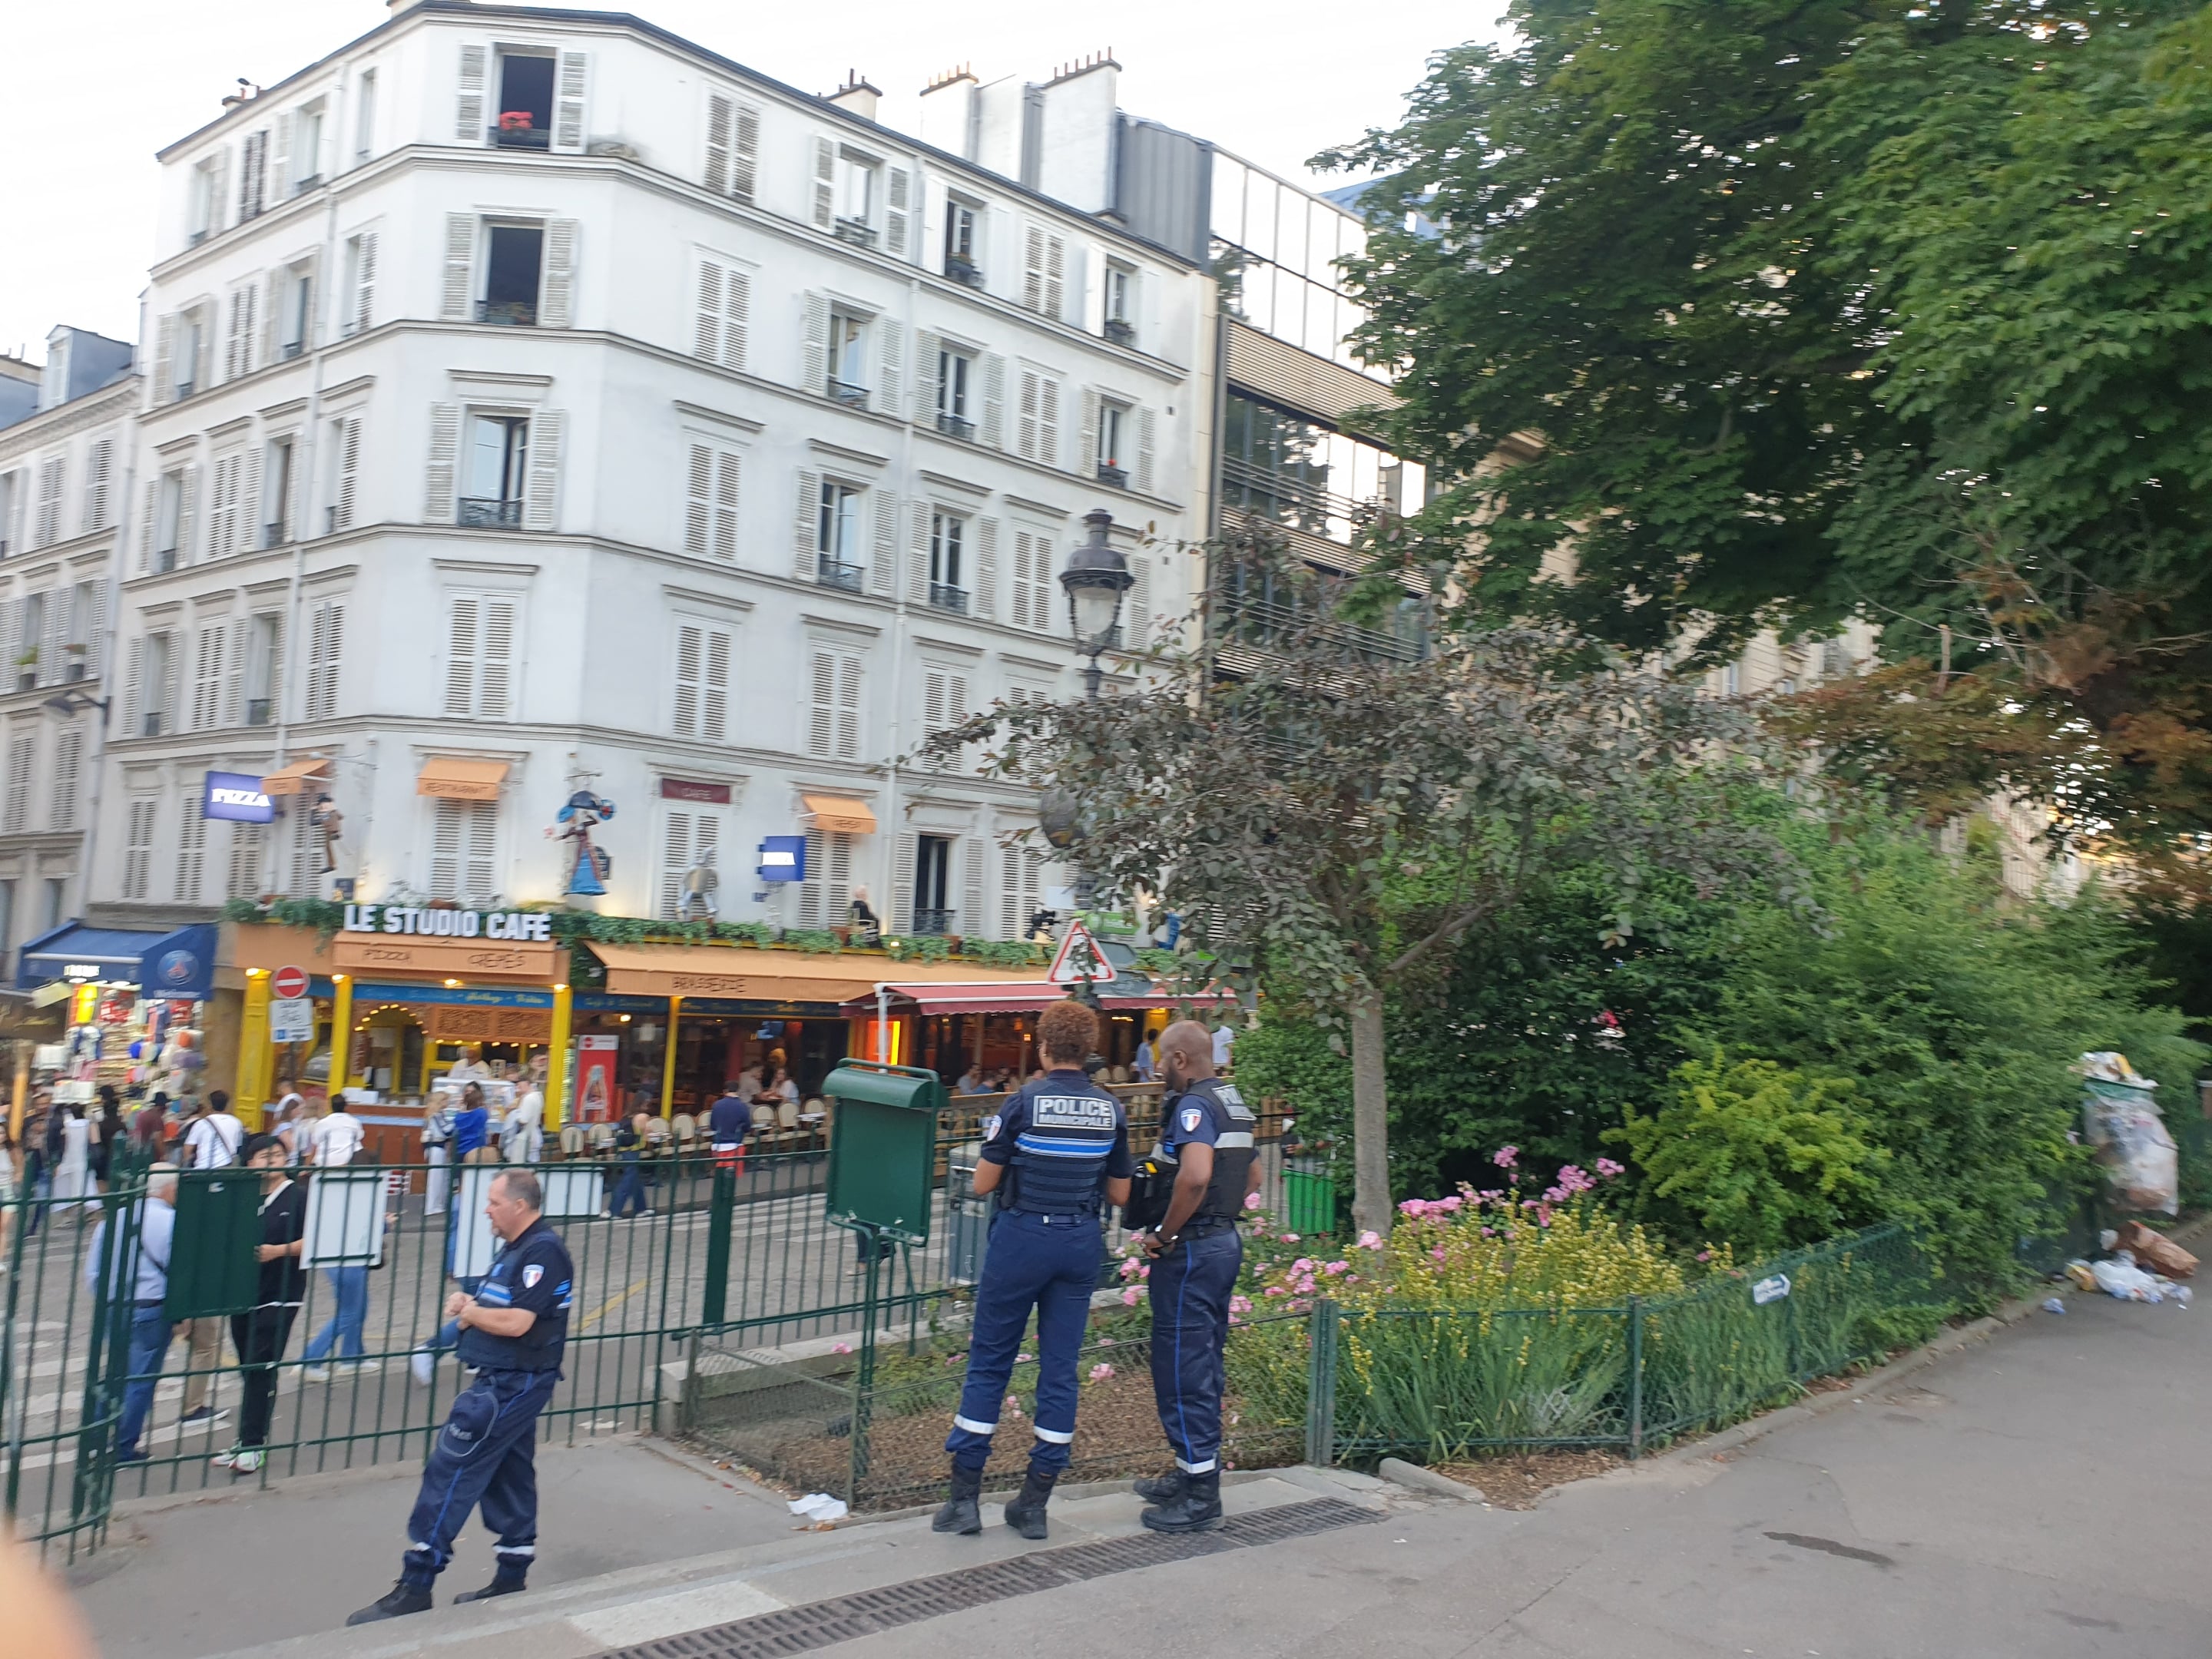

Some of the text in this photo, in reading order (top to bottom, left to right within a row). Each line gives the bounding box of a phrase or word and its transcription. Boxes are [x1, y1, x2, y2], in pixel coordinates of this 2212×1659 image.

[211, 788, 272, 807] PIZZA
[344, 904, 551, 942] LE STUDIO CAFÉ
[1039, 1098, 1111, 1117] POLICE
[1038, 1114, 1111, 1128] MUNICIPALE
